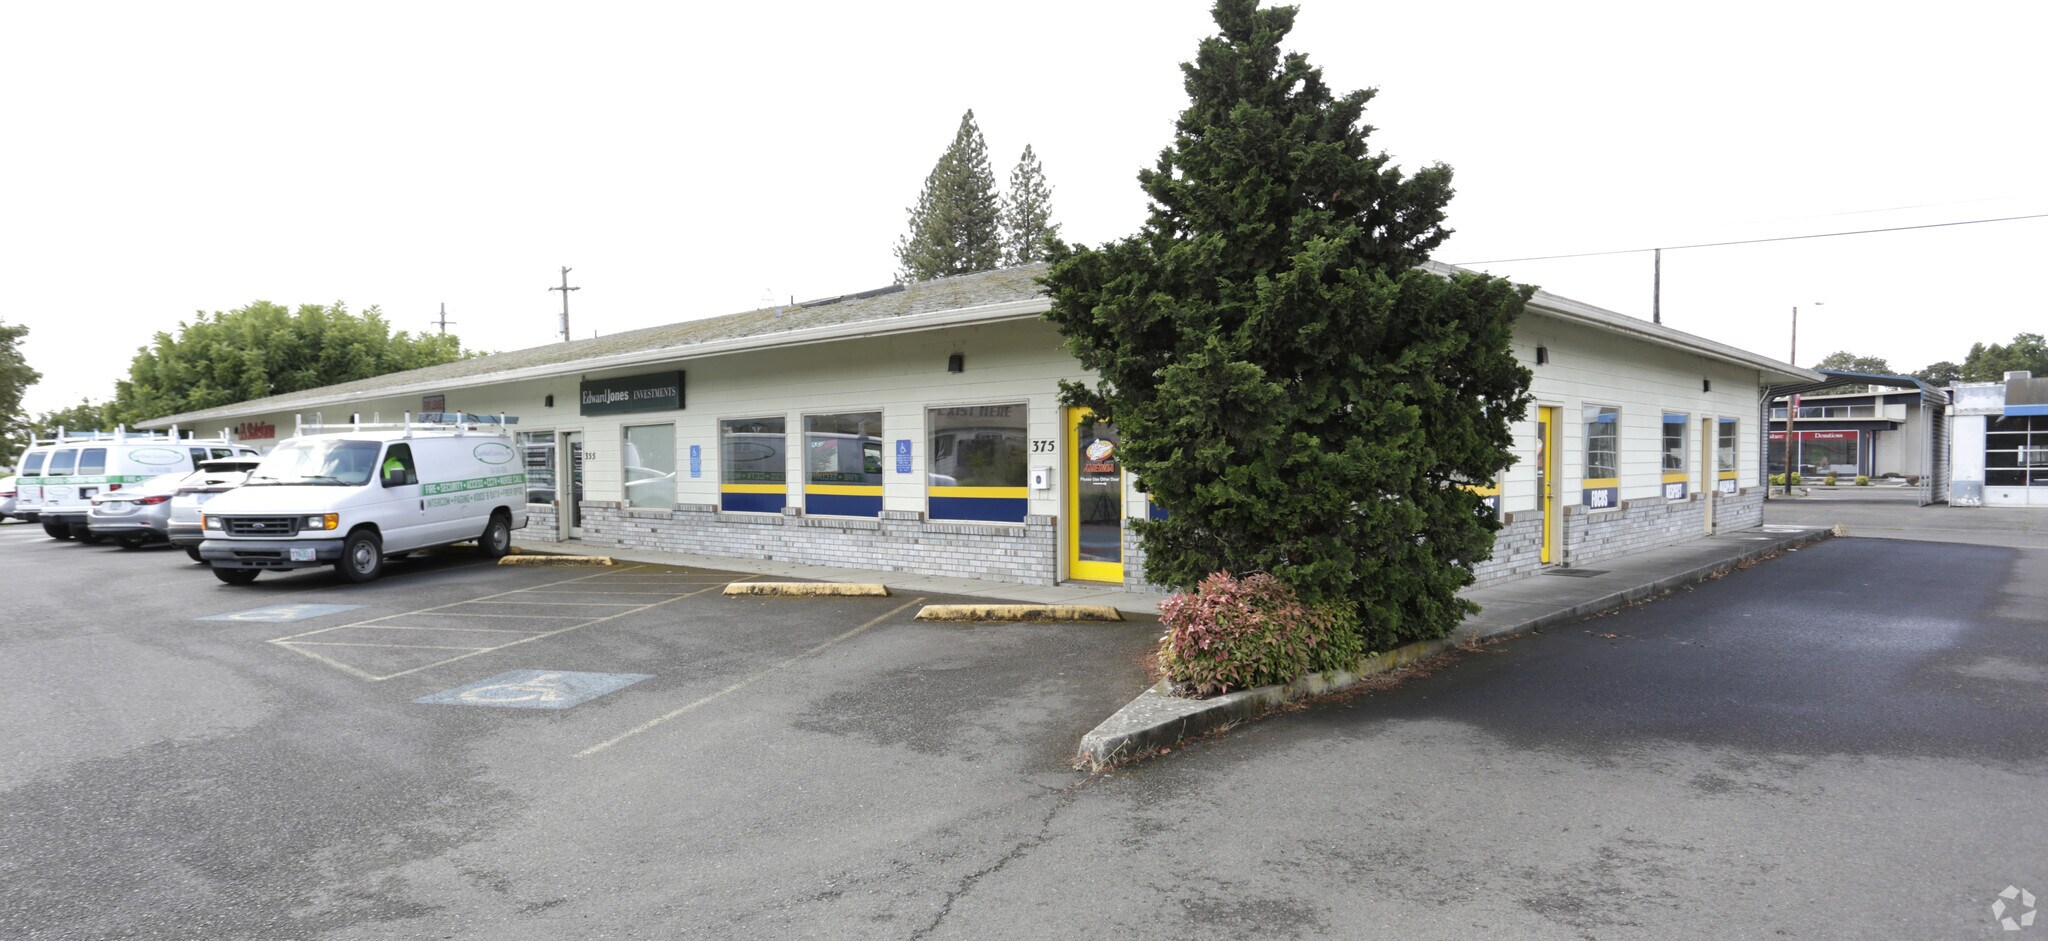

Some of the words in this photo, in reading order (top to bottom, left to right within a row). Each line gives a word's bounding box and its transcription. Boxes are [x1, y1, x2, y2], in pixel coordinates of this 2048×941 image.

[633, 386, 676, 400] INVESTMENTS
[1032, 440, 1055, 452] 375
[425, 483, 436, 495] FIRE
[440, 480, 463, 493] SECURITY
[467, 478, 484, 490] ACCESS
[486, 477, 498, 487] CCTV
[427, 496, 450, 508] INTERCOM
[454, 494, 471, 505] PAGING
[1591, 489, 1608, 508] FOCUS
